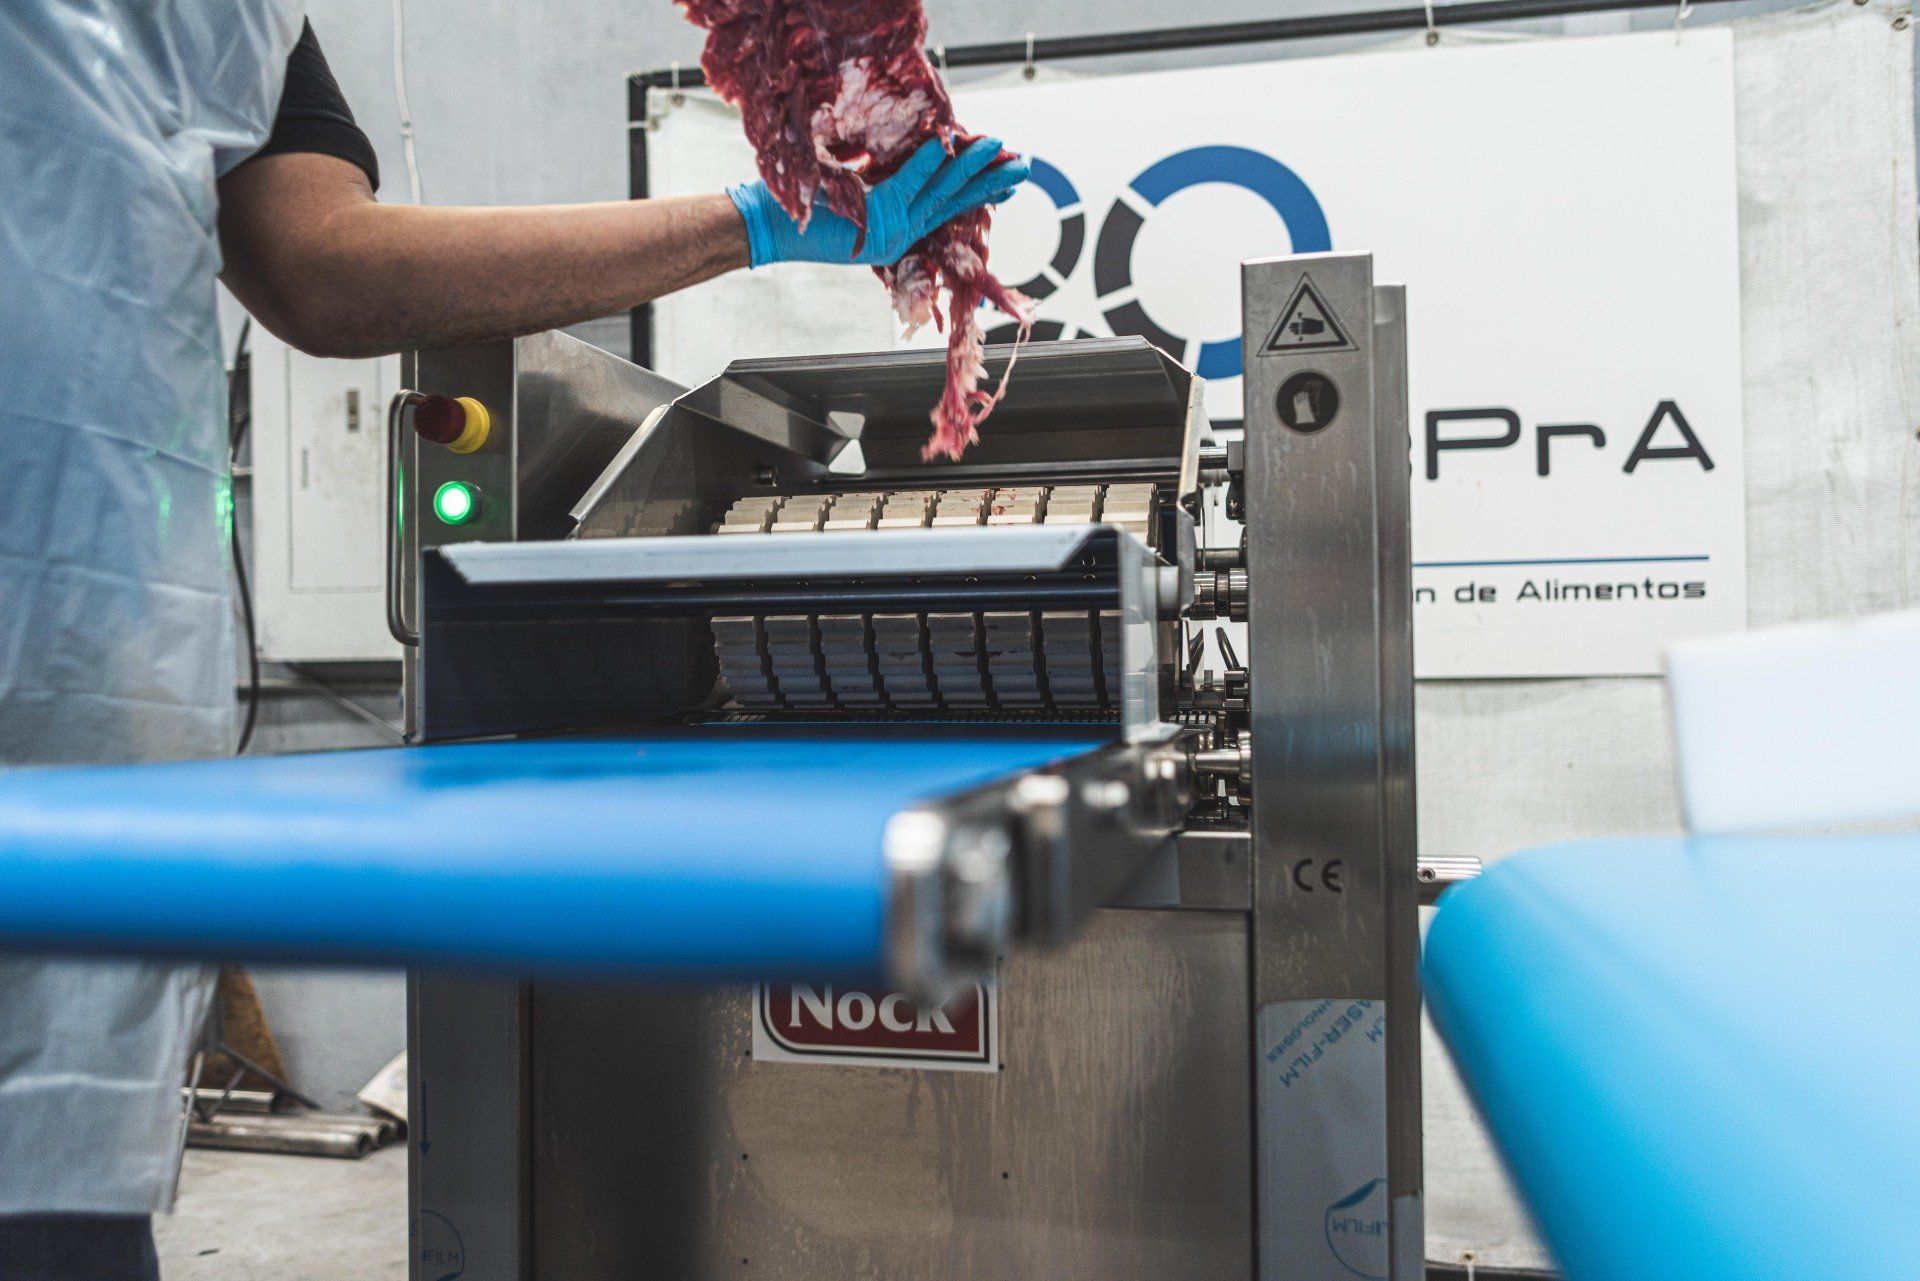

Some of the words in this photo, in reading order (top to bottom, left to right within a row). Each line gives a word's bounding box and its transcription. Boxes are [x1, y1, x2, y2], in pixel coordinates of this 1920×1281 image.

[1408, 400, 1715, 479] PrA
[1455, 580, 1497, 602] de
[1517, 577, 1706, 601] Alimentos
[1293, 858, 1342, 892] CE
